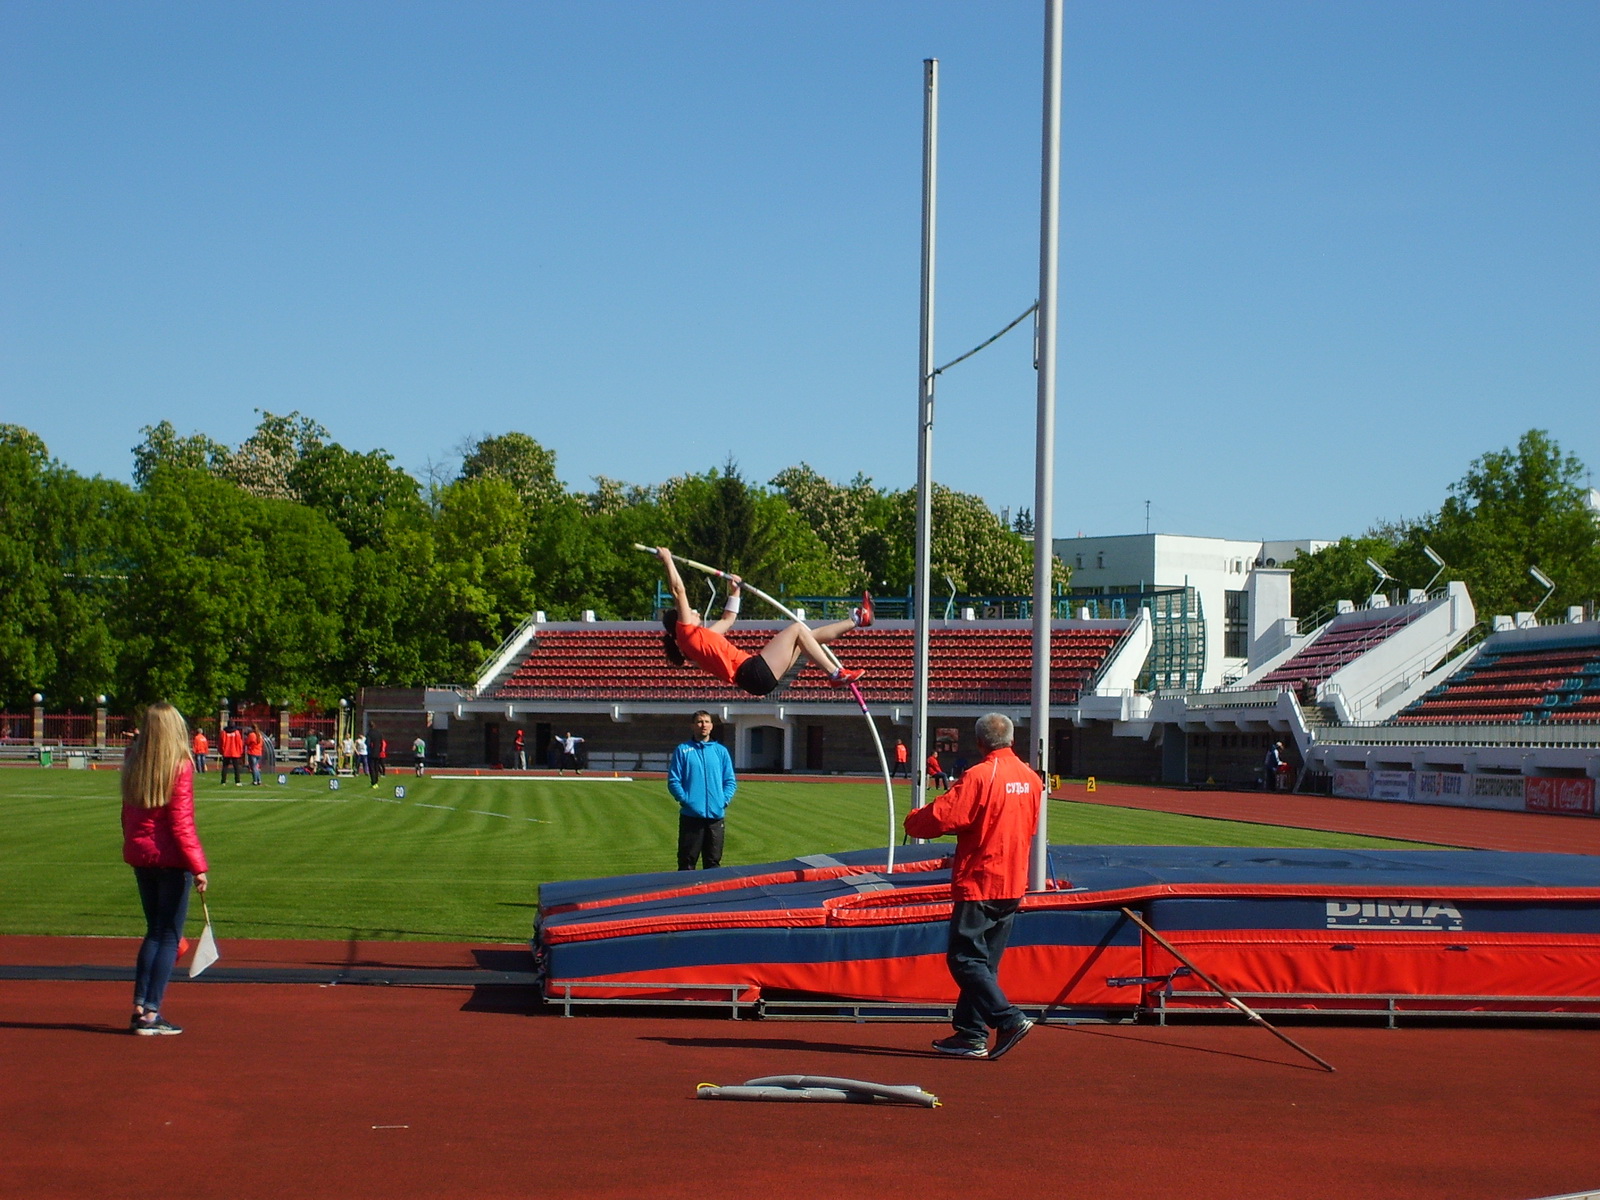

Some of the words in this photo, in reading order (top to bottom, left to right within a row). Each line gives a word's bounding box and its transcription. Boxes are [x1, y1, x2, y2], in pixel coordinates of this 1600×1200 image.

[988, 607, 996, 618] 2
[329, 780, 338, 789] 50
[1005, 782, 1030, 795] СУДЬЯ
[1089, 780, 1094, 789] 2
[395, 787, 404, 797] 60
[1326, 899, 1463, 918] DIMA
[1326, 917, 1463, 925] SPORT
